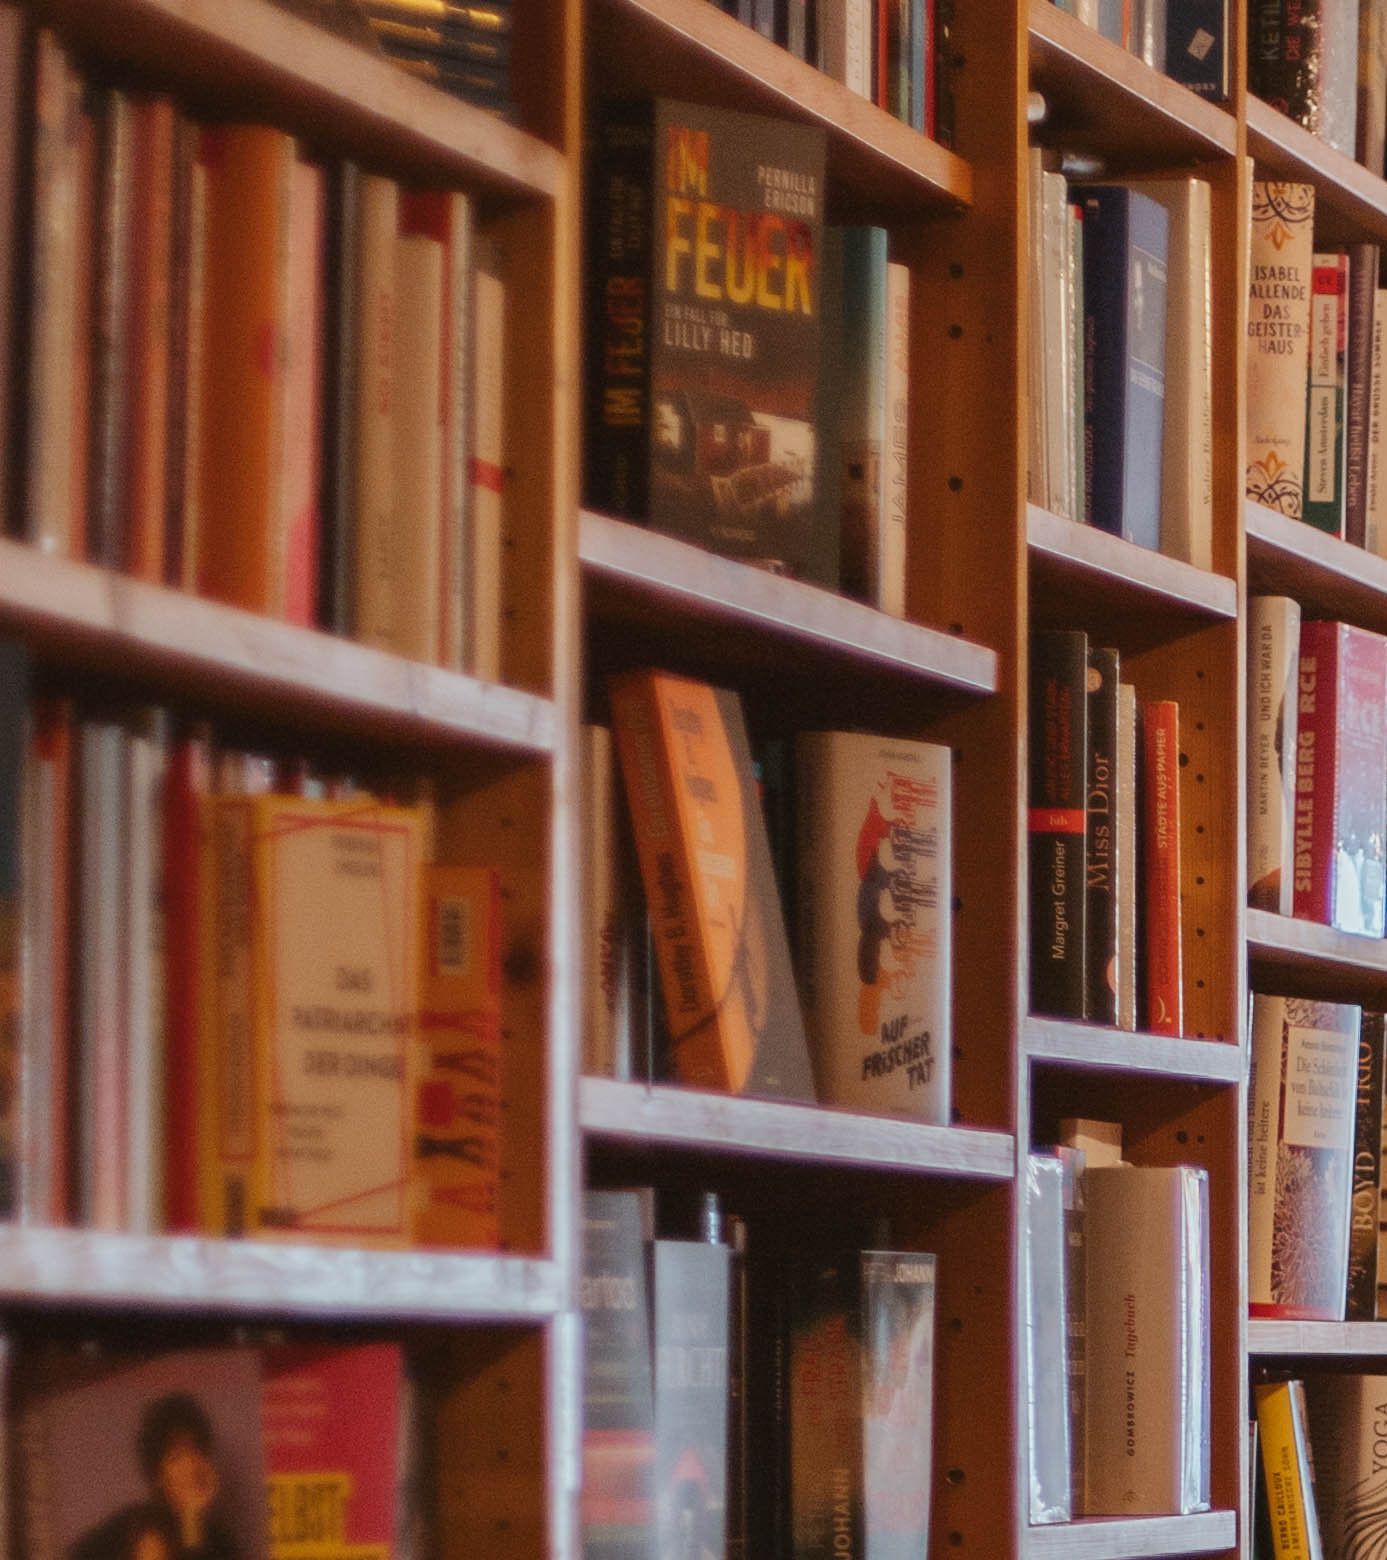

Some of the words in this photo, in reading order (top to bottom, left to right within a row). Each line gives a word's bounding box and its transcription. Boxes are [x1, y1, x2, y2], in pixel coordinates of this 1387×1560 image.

[667, 126, 708, 197] IM
[757, 165, 816, 193] PERNILLA
[764, 191, 814, 217] ERICSON
[665, 197, 814, 316] FEUER
[1254, 264, 1301, 283] ISABEL
[1249, 283, 1306, 301] ALLENDE
[1262, 302, 1291, 320] DAS
[664, 319, 712, 351] LILLY
[1258, 338, 1295, 356] HAUS
[1318, 337, 1331, 378] Einfach
[1316, 458, 1329, 494] Steven
[1263, 624, 1272, 640] DA
[1262, 642, 1272, 670] WAR
[1262, 672, 1271, 693] ICH
[1298, 656, 1317, 714] RCE
[1261, 696, 1271, 722] UND
[1158, 727, 1168, 772] PAPIER
[1297, 730, 1314, 793] BERG
[1086, 752, 1110, 815] Dior
[1158, 774, 1168, 799] AUS
[1259, 773, 1268, 816] MARTIN
[1086, 825, 1110, 892] Miss
[1295, 798, 1312, 892] SIBYLLE
[1051, 840, 1066, 897] Greiner
[1051, 901, 1069, 961] Margret
[1255, 1145, 1269, 1178] keine
[1353, 1150, 1376, 1230] BOYD
[1124, 1293, 1137, 1359] Tagebuch
